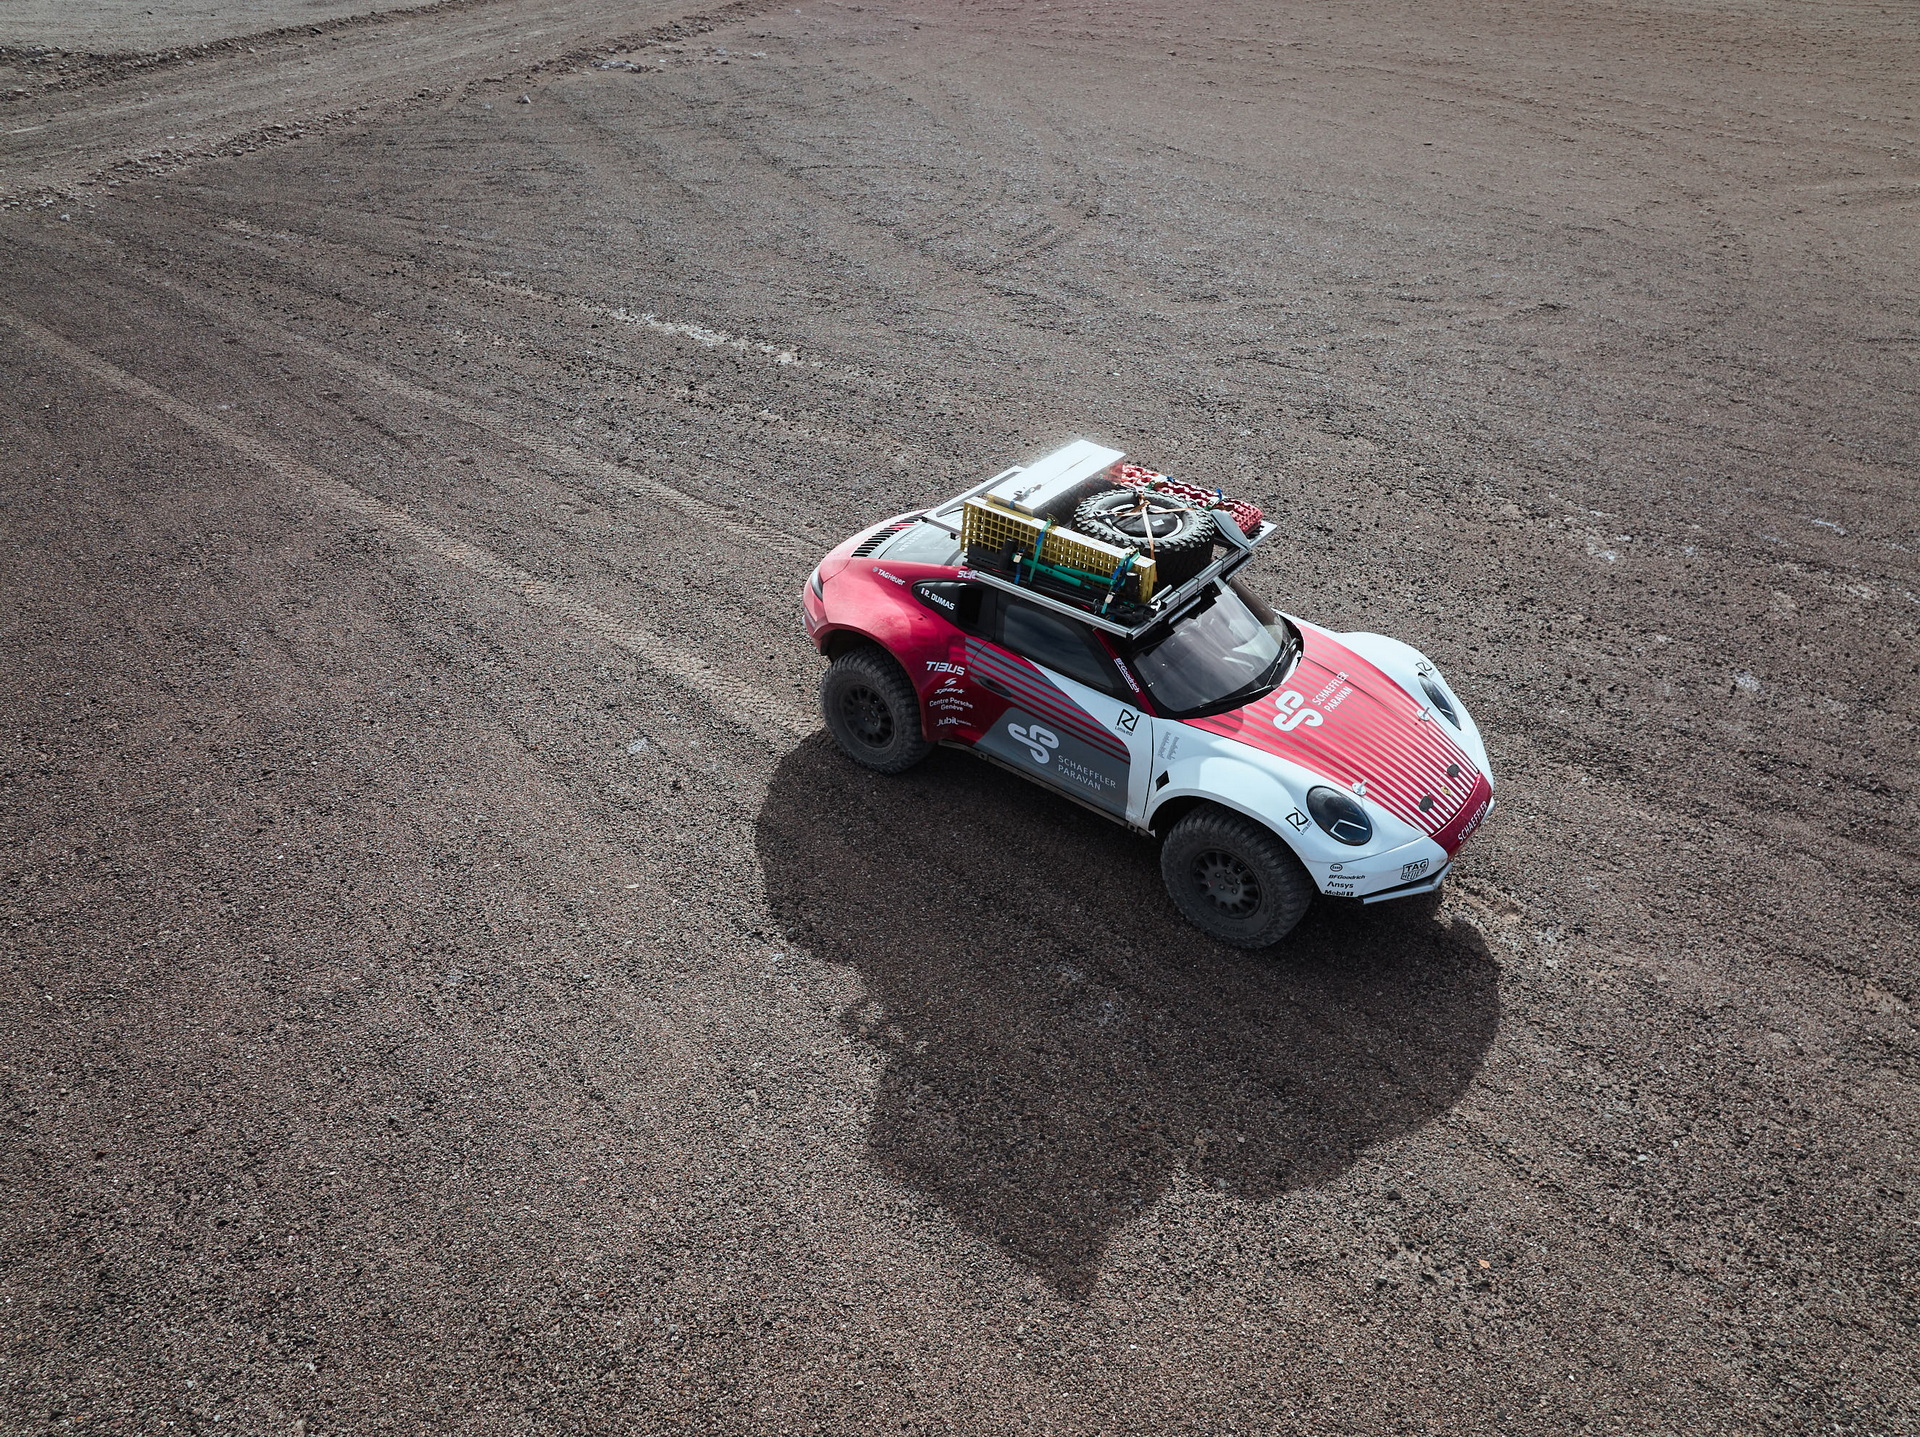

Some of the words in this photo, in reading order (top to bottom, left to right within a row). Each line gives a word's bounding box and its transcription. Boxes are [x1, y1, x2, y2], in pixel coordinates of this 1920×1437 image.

[931, 594, 955, 611] DUMAS
[1312, 671, 1350, 706] SCHAEFFLER
[1323, 686, 1353, 713] PARAVAN
[929, 698, 949, 707] Centre
[950, 697, 974, 709] Porsche
[1058, 755, 1116, 789] SCHAEFFLER
[1058, 764, 1101, 791] PARAVAN
[1457, 800, 1488, 844] SCHAEFFLER
[1405, 861, 1427, 872] TAG
[1326, 881, 1354, 889] Ansys
